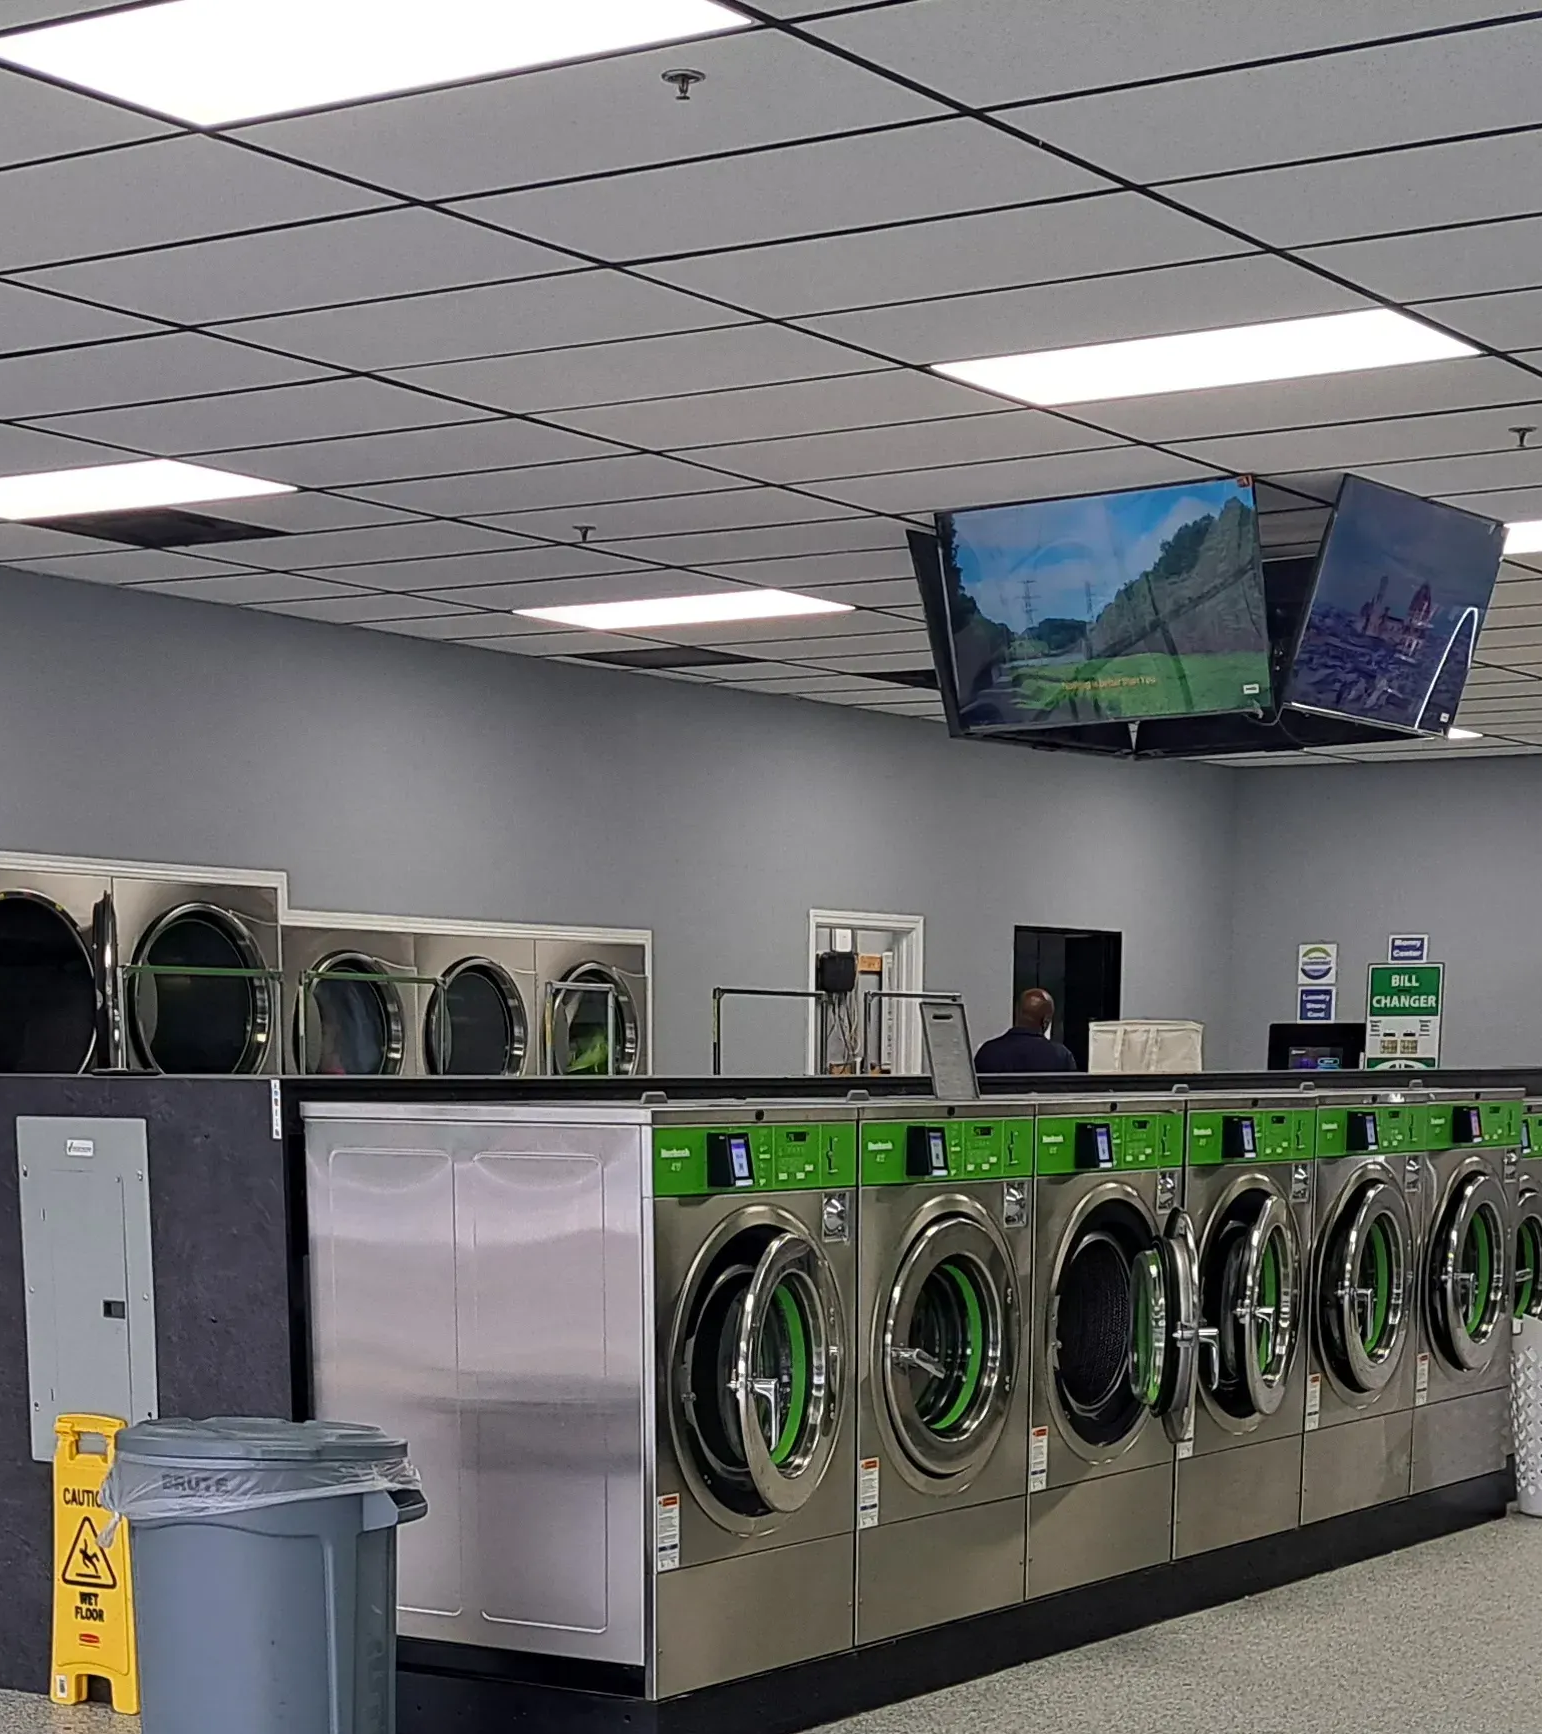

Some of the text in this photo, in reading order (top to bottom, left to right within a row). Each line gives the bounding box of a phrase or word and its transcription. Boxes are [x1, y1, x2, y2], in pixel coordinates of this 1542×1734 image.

[1394, 939, 1422, 949] Money
[1391, 974, 1420, 987] BILL
[1372, 995, 1437, 1008] CHANGER
[162, 1474, 230, 1494] BRUTE
[63, 1487, 102, 1508] CAUTIO
[79, 1591, 100, 1607] WET
[75, 1605, 105, 1622] FLOOR
